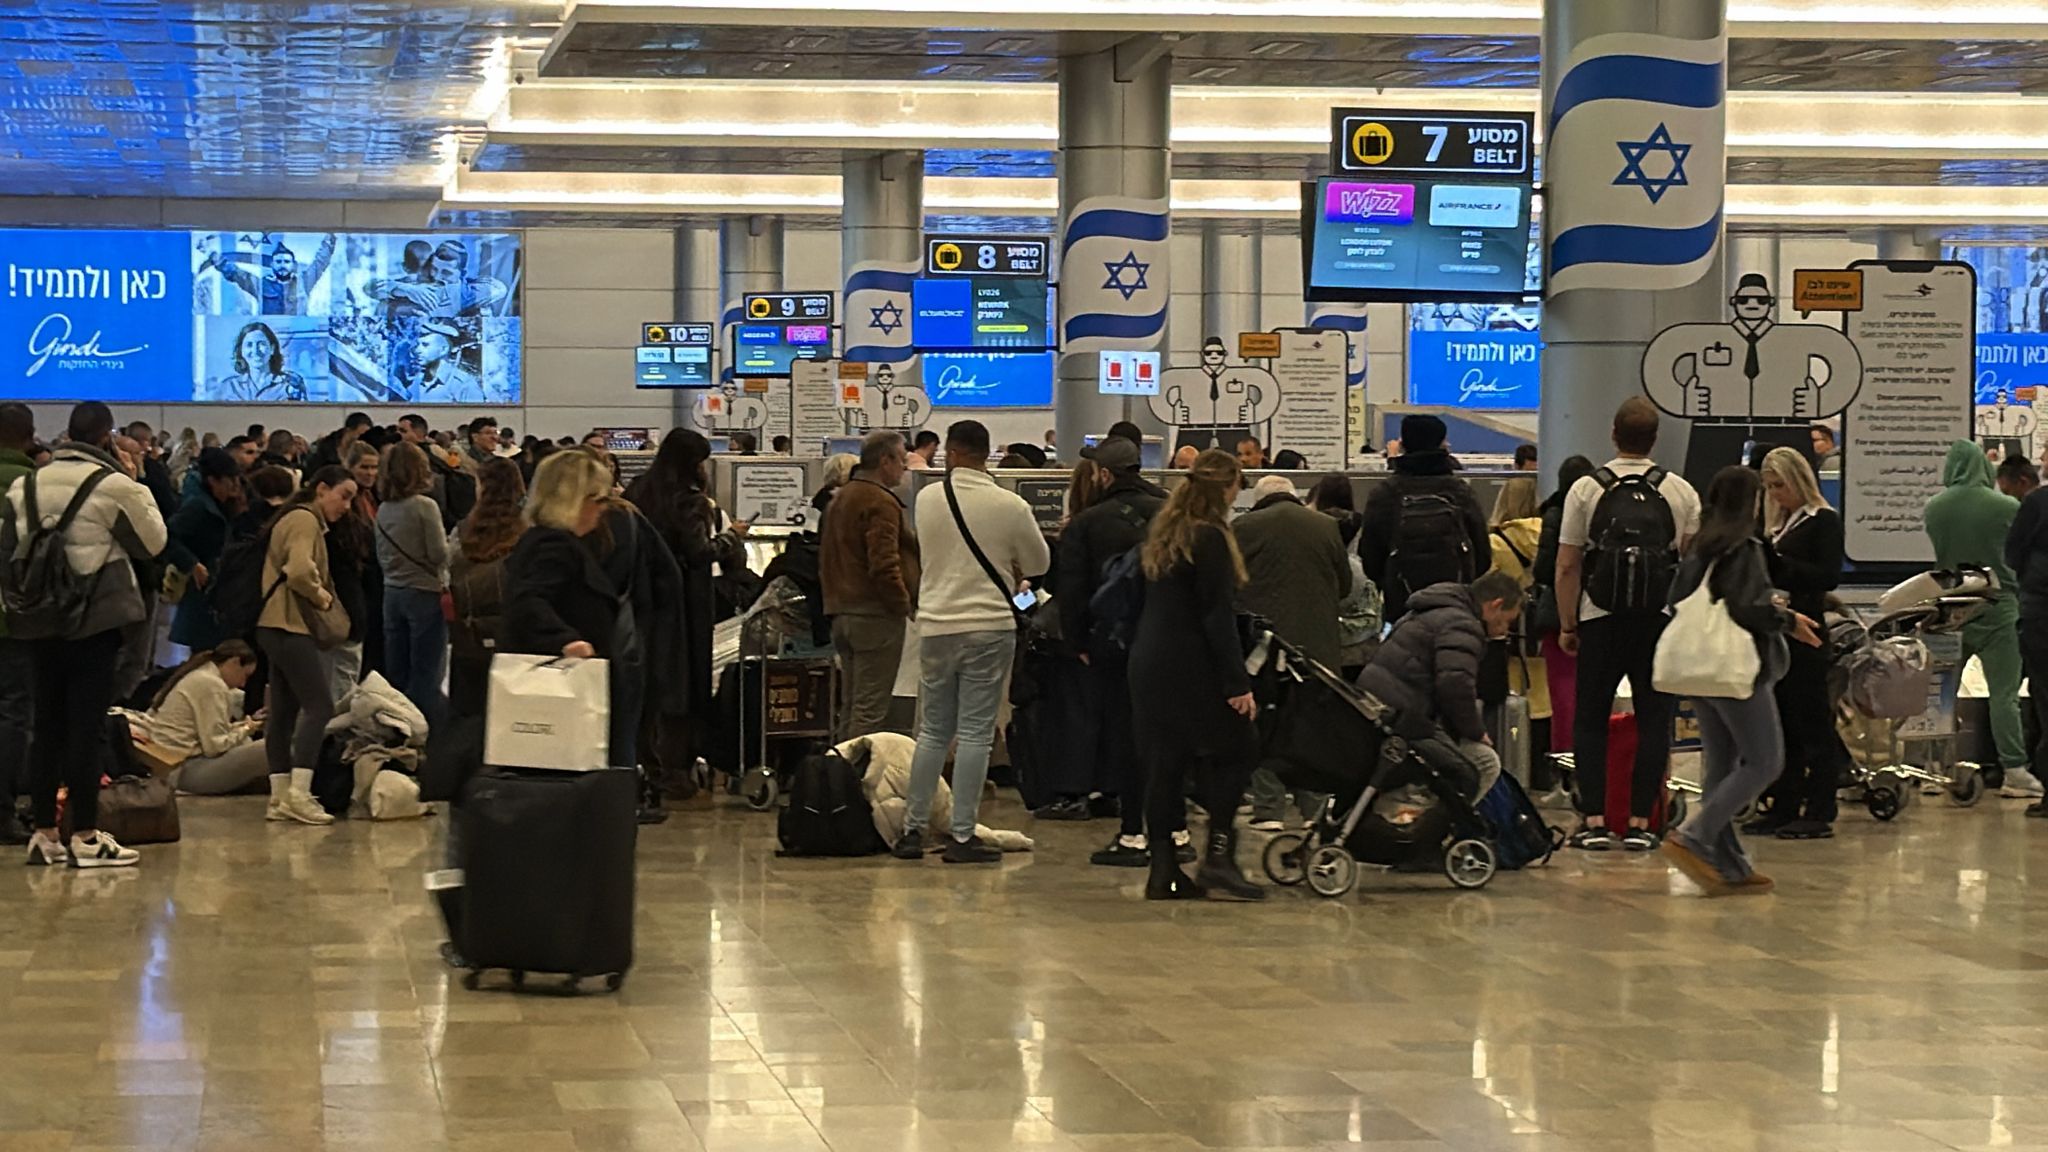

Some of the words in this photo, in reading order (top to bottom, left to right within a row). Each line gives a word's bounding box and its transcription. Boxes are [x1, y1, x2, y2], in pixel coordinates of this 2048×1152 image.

[1422, 126, 1448, 162] 7
[1468, 128, 1518, 144] מסוע
[1474, 148, 1517, 163] BELT
[978, 245, 996, 269] 8
[1007, 246, 1039, 257] מסוע
[1011, 260, 1039, 269] BELT
[9, 264, 110, 298] ולתמיד!
[121, 269, 166, 304] כאן
[781, 298, 795, 316] 9
[669, 327, 688, 341] 10
[1446, 341, 1504, 362] ולתמיד!
[1510, 344, 1535, 365] כאן
[1976, 344, 2018, 364] ולתמי
